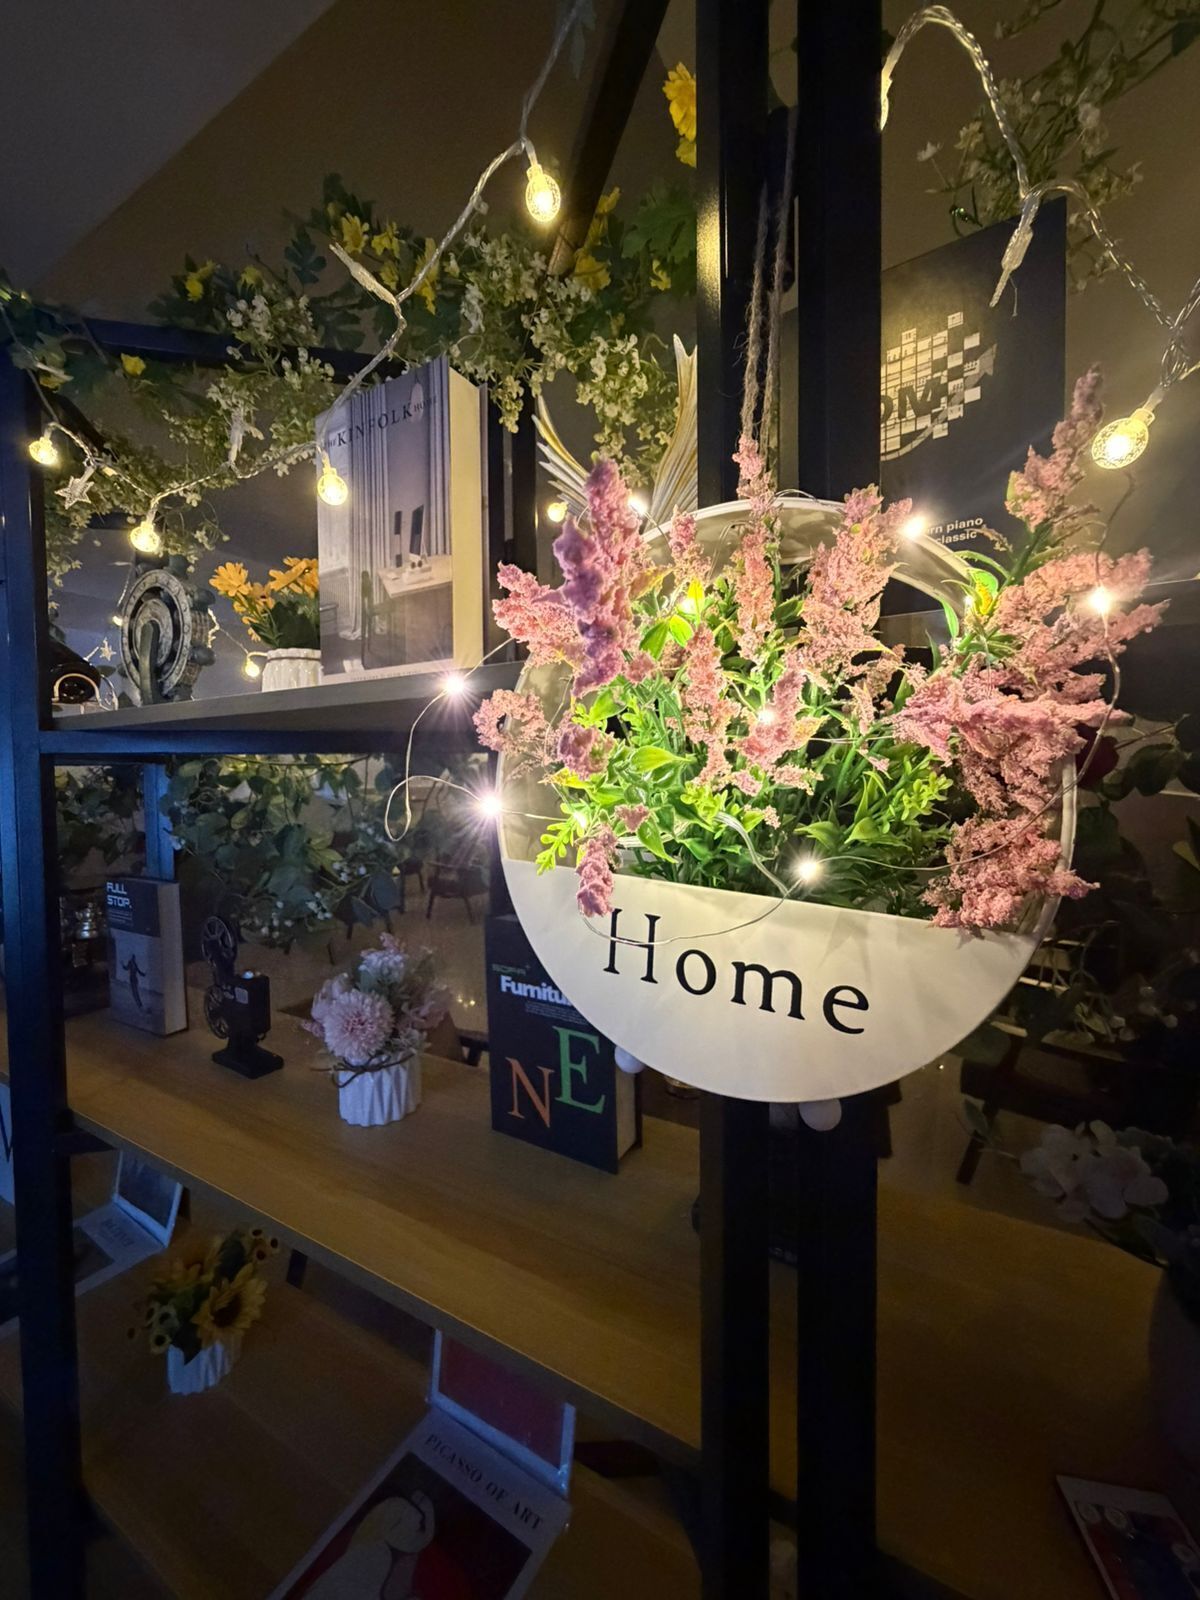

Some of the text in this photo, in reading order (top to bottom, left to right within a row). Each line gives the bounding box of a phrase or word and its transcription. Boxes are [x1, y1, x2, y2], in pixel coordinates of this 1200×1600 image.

[337, 402, 413, 447] KINFOLK
[936, 530, 978, 545] classic
[946, 517, 984, 534] piano
[106, 881, 127, 895] FULL
[603, 908, 870, 1035] Home
[424, 1433, 543, 1529] PICASSO OF ART
